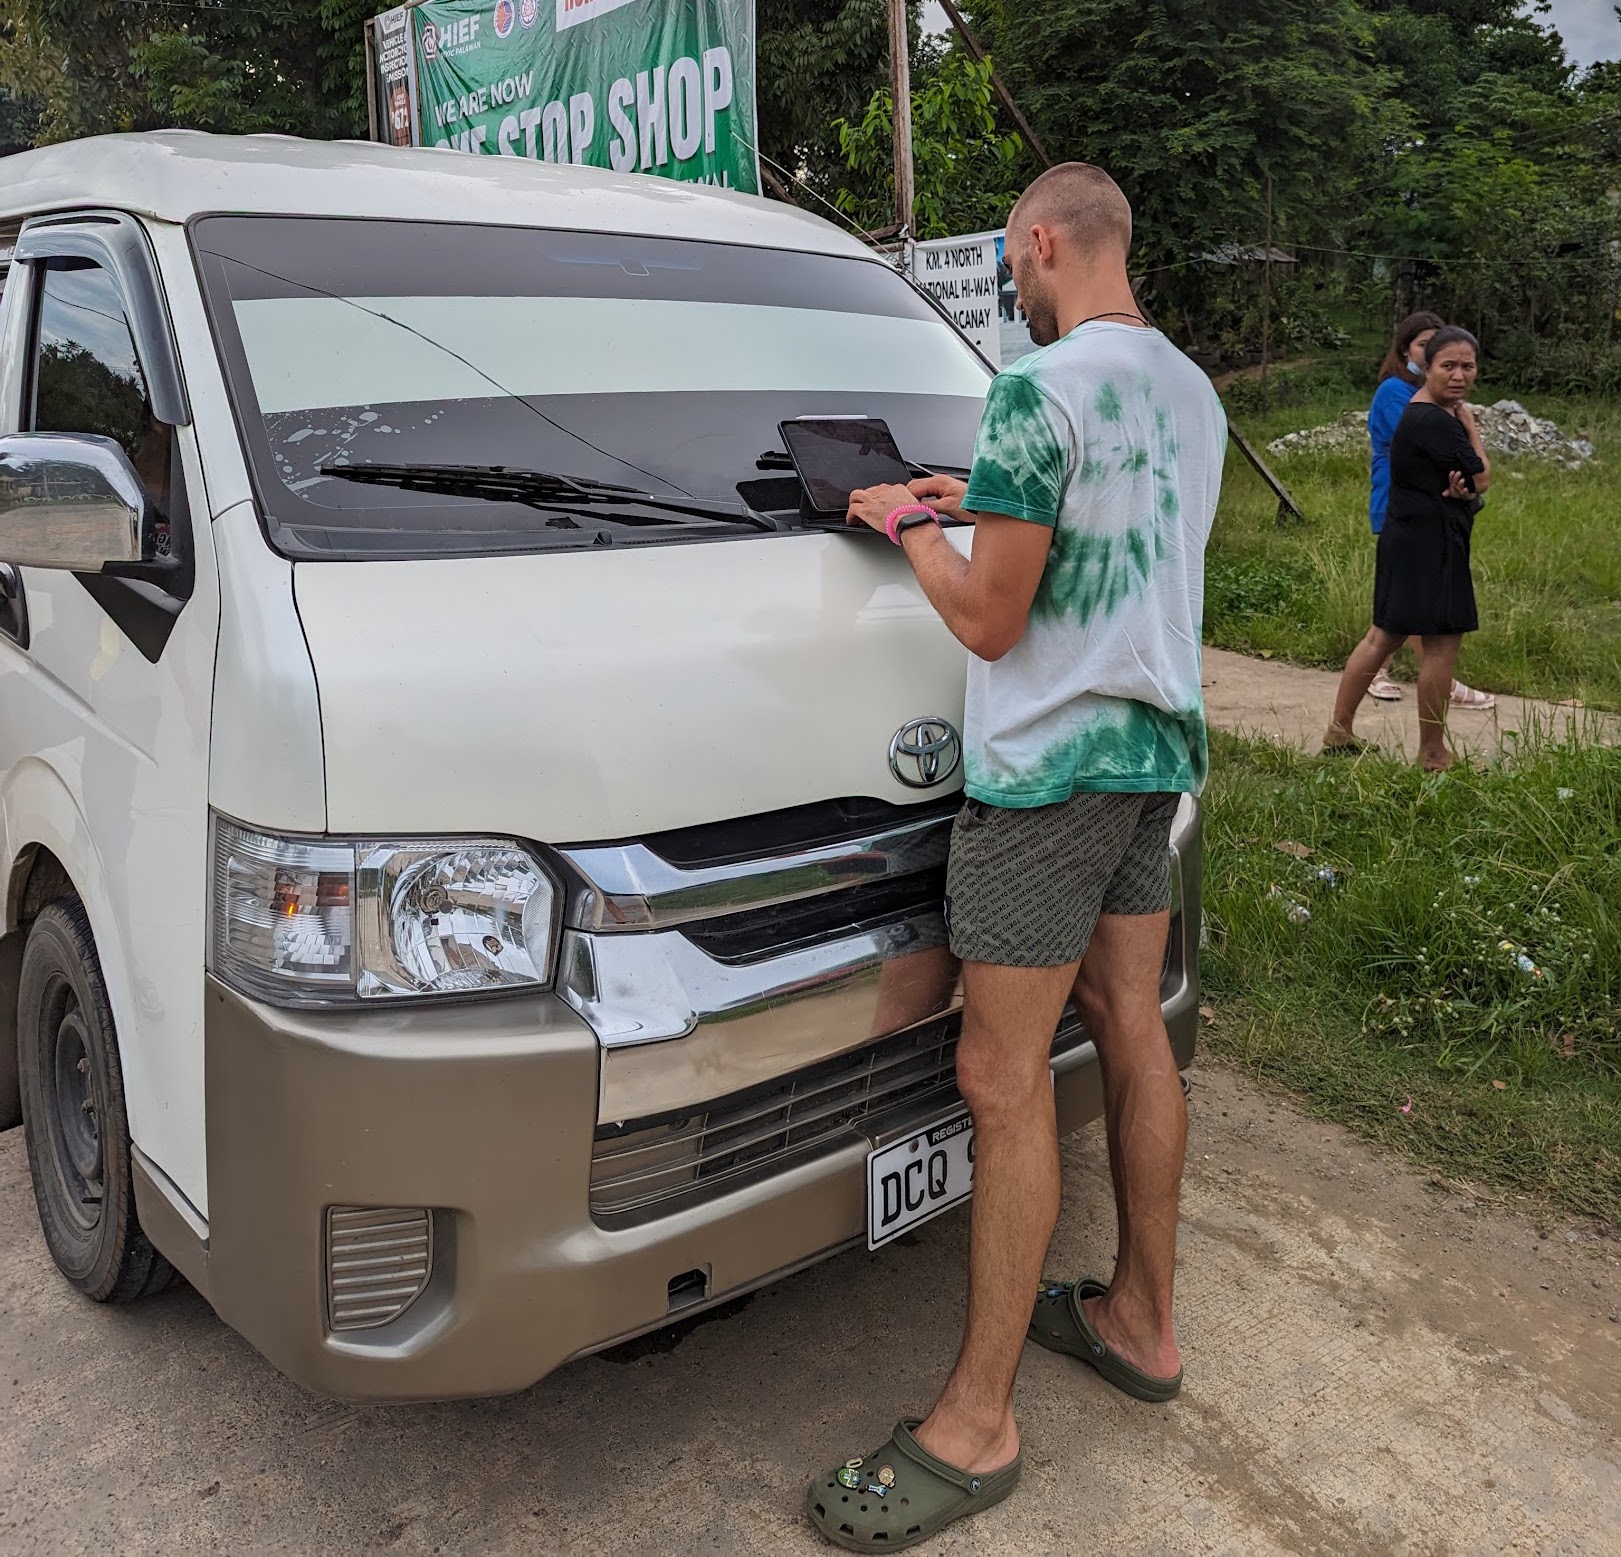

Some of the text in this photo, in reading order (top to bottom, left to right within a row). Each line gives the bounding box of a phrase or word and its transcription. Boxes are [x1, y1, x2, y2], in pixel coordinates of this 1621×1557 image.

[379, 44, 407, 63] MOTORCYC
[435, 70, 533, 127] WE ARE NOW
[608, 46, 733, 173] SHOP
[926, 246, 983, 271] KM. 4 NORTH
[916, 276, 997, 300] TIONAL HI-WAY
[932, 1117, 973, 1143] REGISTE
[881, 1150, 947, 1227] DCQ
